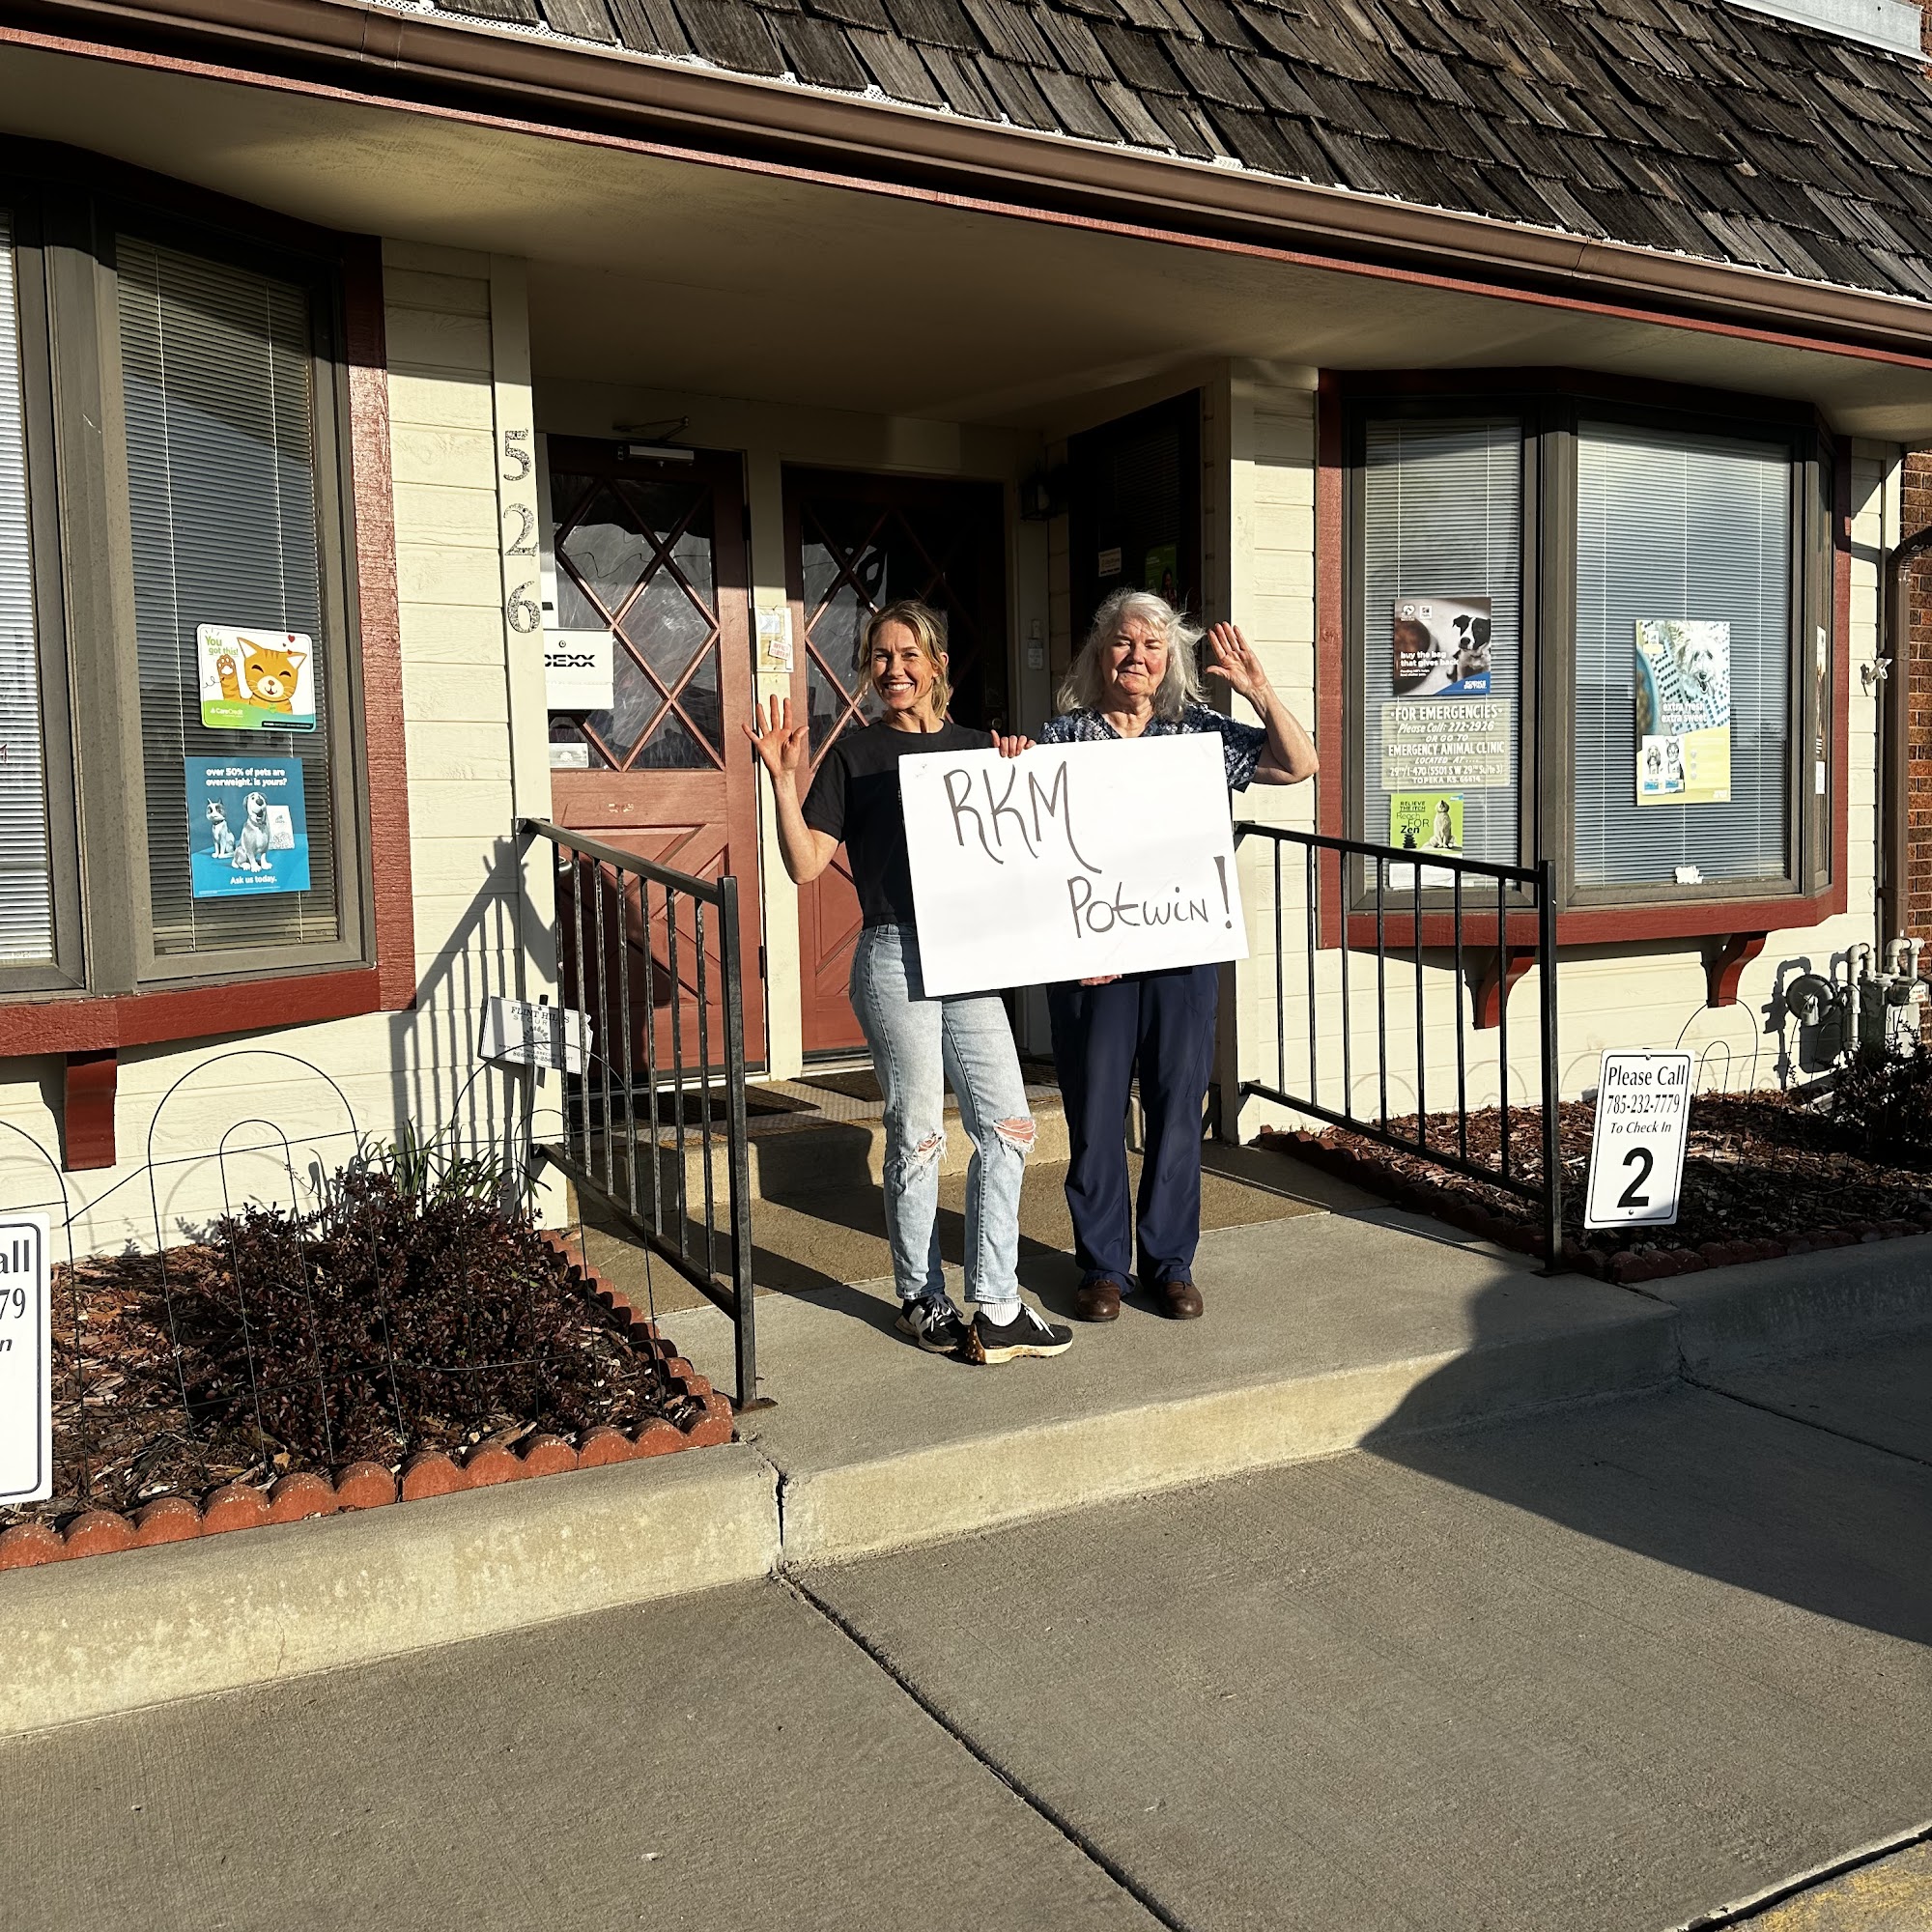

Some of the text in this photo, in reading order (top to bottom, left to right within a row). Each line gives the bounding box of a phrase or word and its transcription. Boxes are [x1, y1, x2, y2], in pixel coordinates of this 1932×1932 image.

[205, 635, 222, 646] You
[544, 654, 595, 668] DEXX
[1401, 651, 1415, 660] buy
[1418, 659, 1438, 668] gives
[1663, 701, 1705, 711] extra fresh
[1396, 704, 1497, 721] FOR EMERGENCIES
[1662, 714, 1707, 723] extra sweet
[1398, 724, 1426, 733] Please
[1427, 723, 1446, 732] Call:
[1388, 741, 1505, 756] EMERGENCY ANIMAL CLINIC
[254, 768, 271, 777] pets
[1479, 764, 1495, 774] Suite
[206, 778, 253, 787] overweight.
[262, 778, 288, 787] yours?
[943, 760, 1102, 874] RKM
[255, 874, 277, 884] today.
[511, 1007, 570, 1024] FLINT HILS
[1608, 1065, 1686, 1086] Please Call
[1606, 1094, 1680, 1114] 785-232-7779
[1610, 1121, 1672, 1133] To Check In
[1616, 1147, 1654, 1208] 2
[0, 1239, 30, 1274] all
